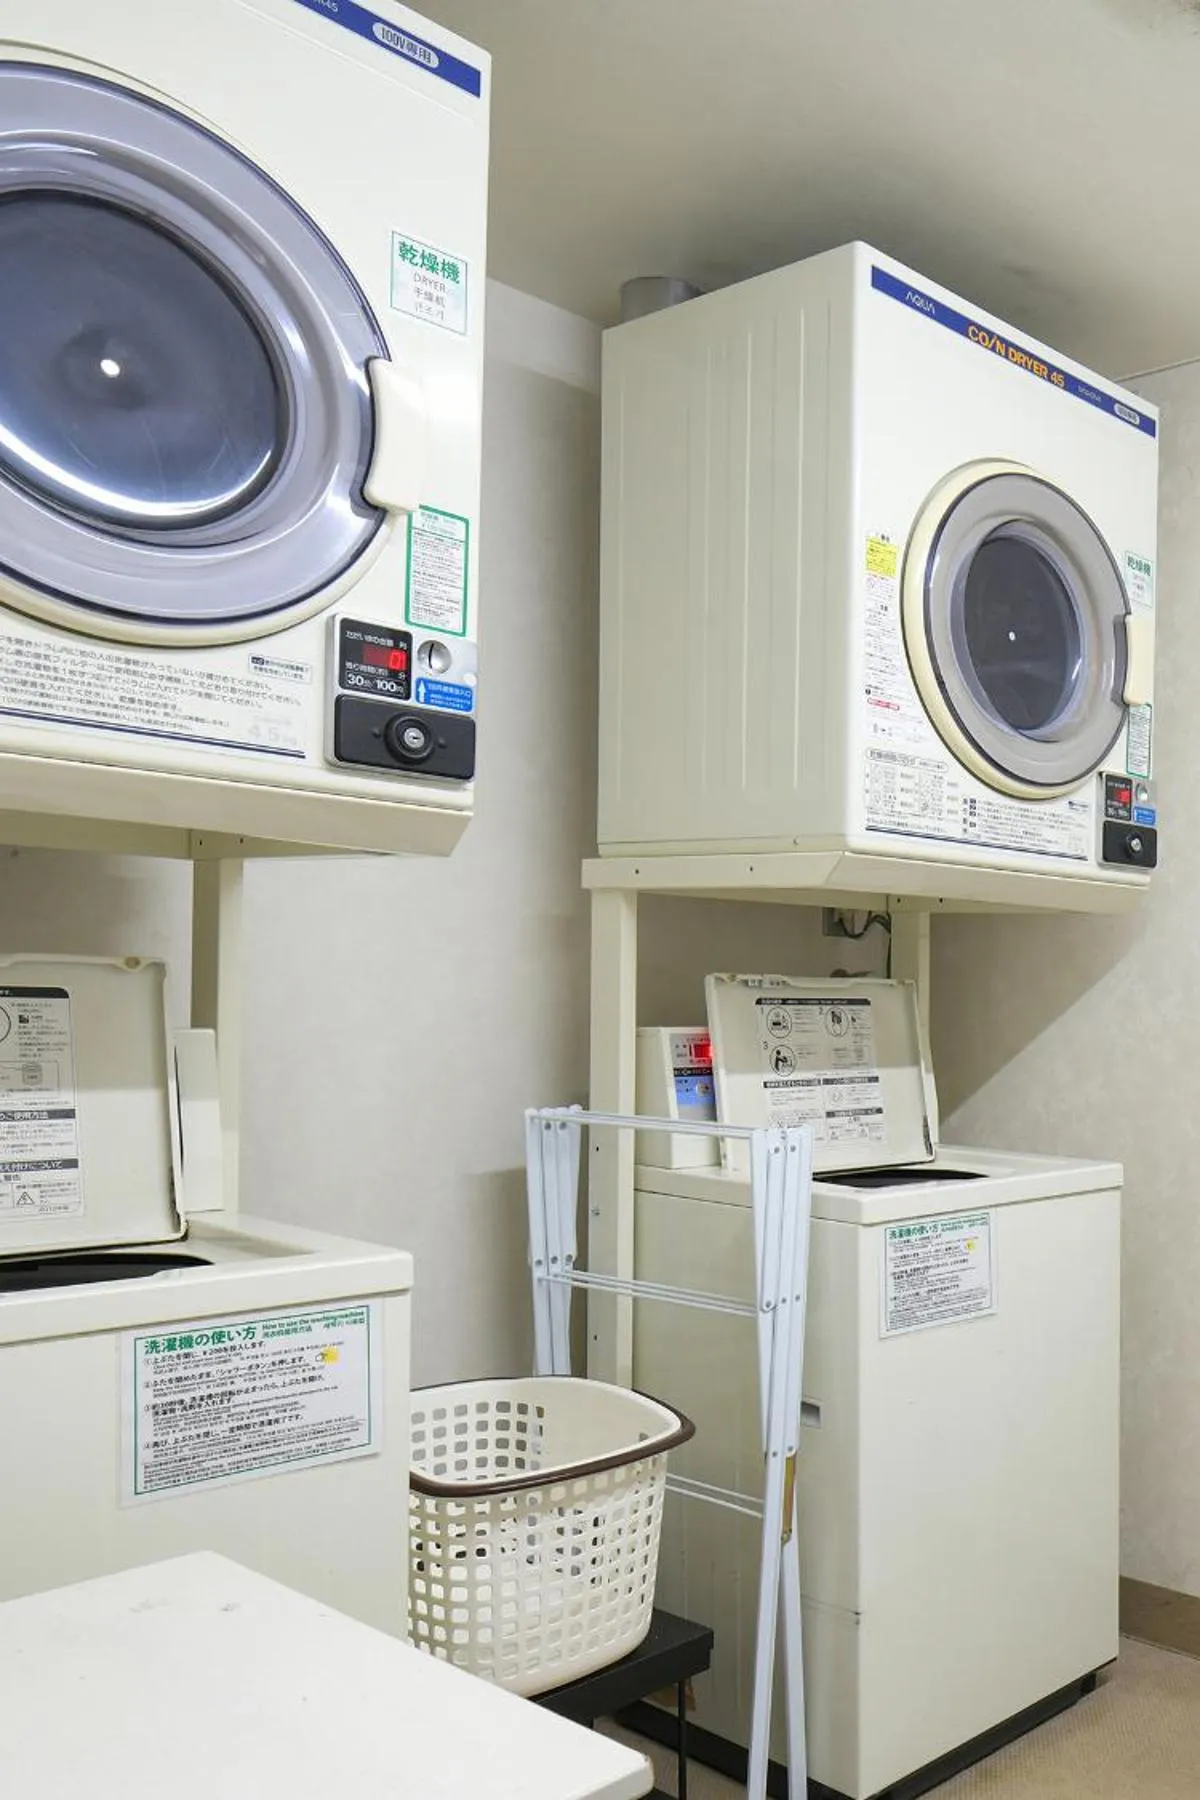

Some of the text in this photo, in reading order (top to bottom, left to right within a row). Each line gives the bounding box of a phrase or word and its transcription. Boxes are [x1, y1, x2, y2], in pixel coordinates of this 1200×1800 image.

[398, 240, 460, 284] 乾燥機
[1008, 346, 1048, 380] DRYER
[1050, 368, 1065, 388] 45
[144, 1326, 257, 1355] 洗濯機の使い方
